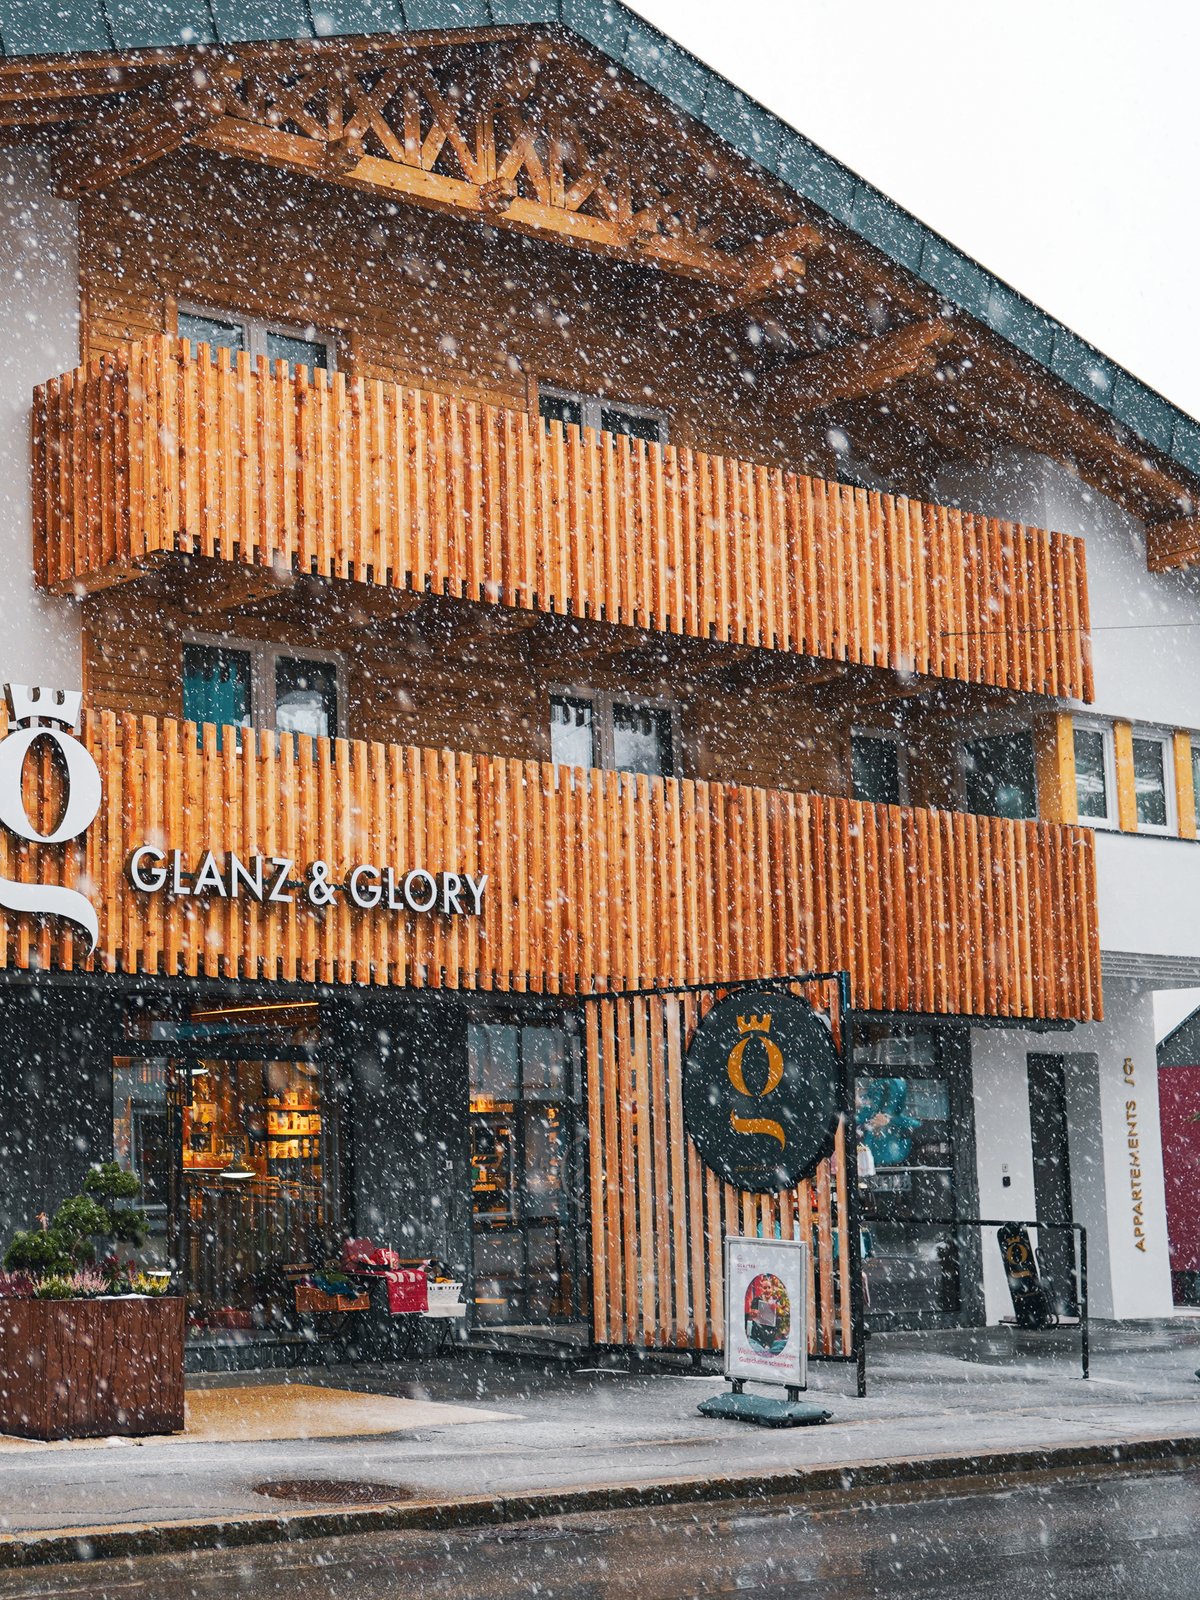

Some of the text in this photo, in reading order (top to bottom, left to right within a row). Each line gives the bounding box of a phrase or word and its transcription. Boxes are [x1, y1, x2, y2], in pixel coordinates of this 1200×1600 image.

[130, 845, 489, 916] GLANZ & GLORY
[1125, 1100, 1147, 1253] APPARTEMENTS
